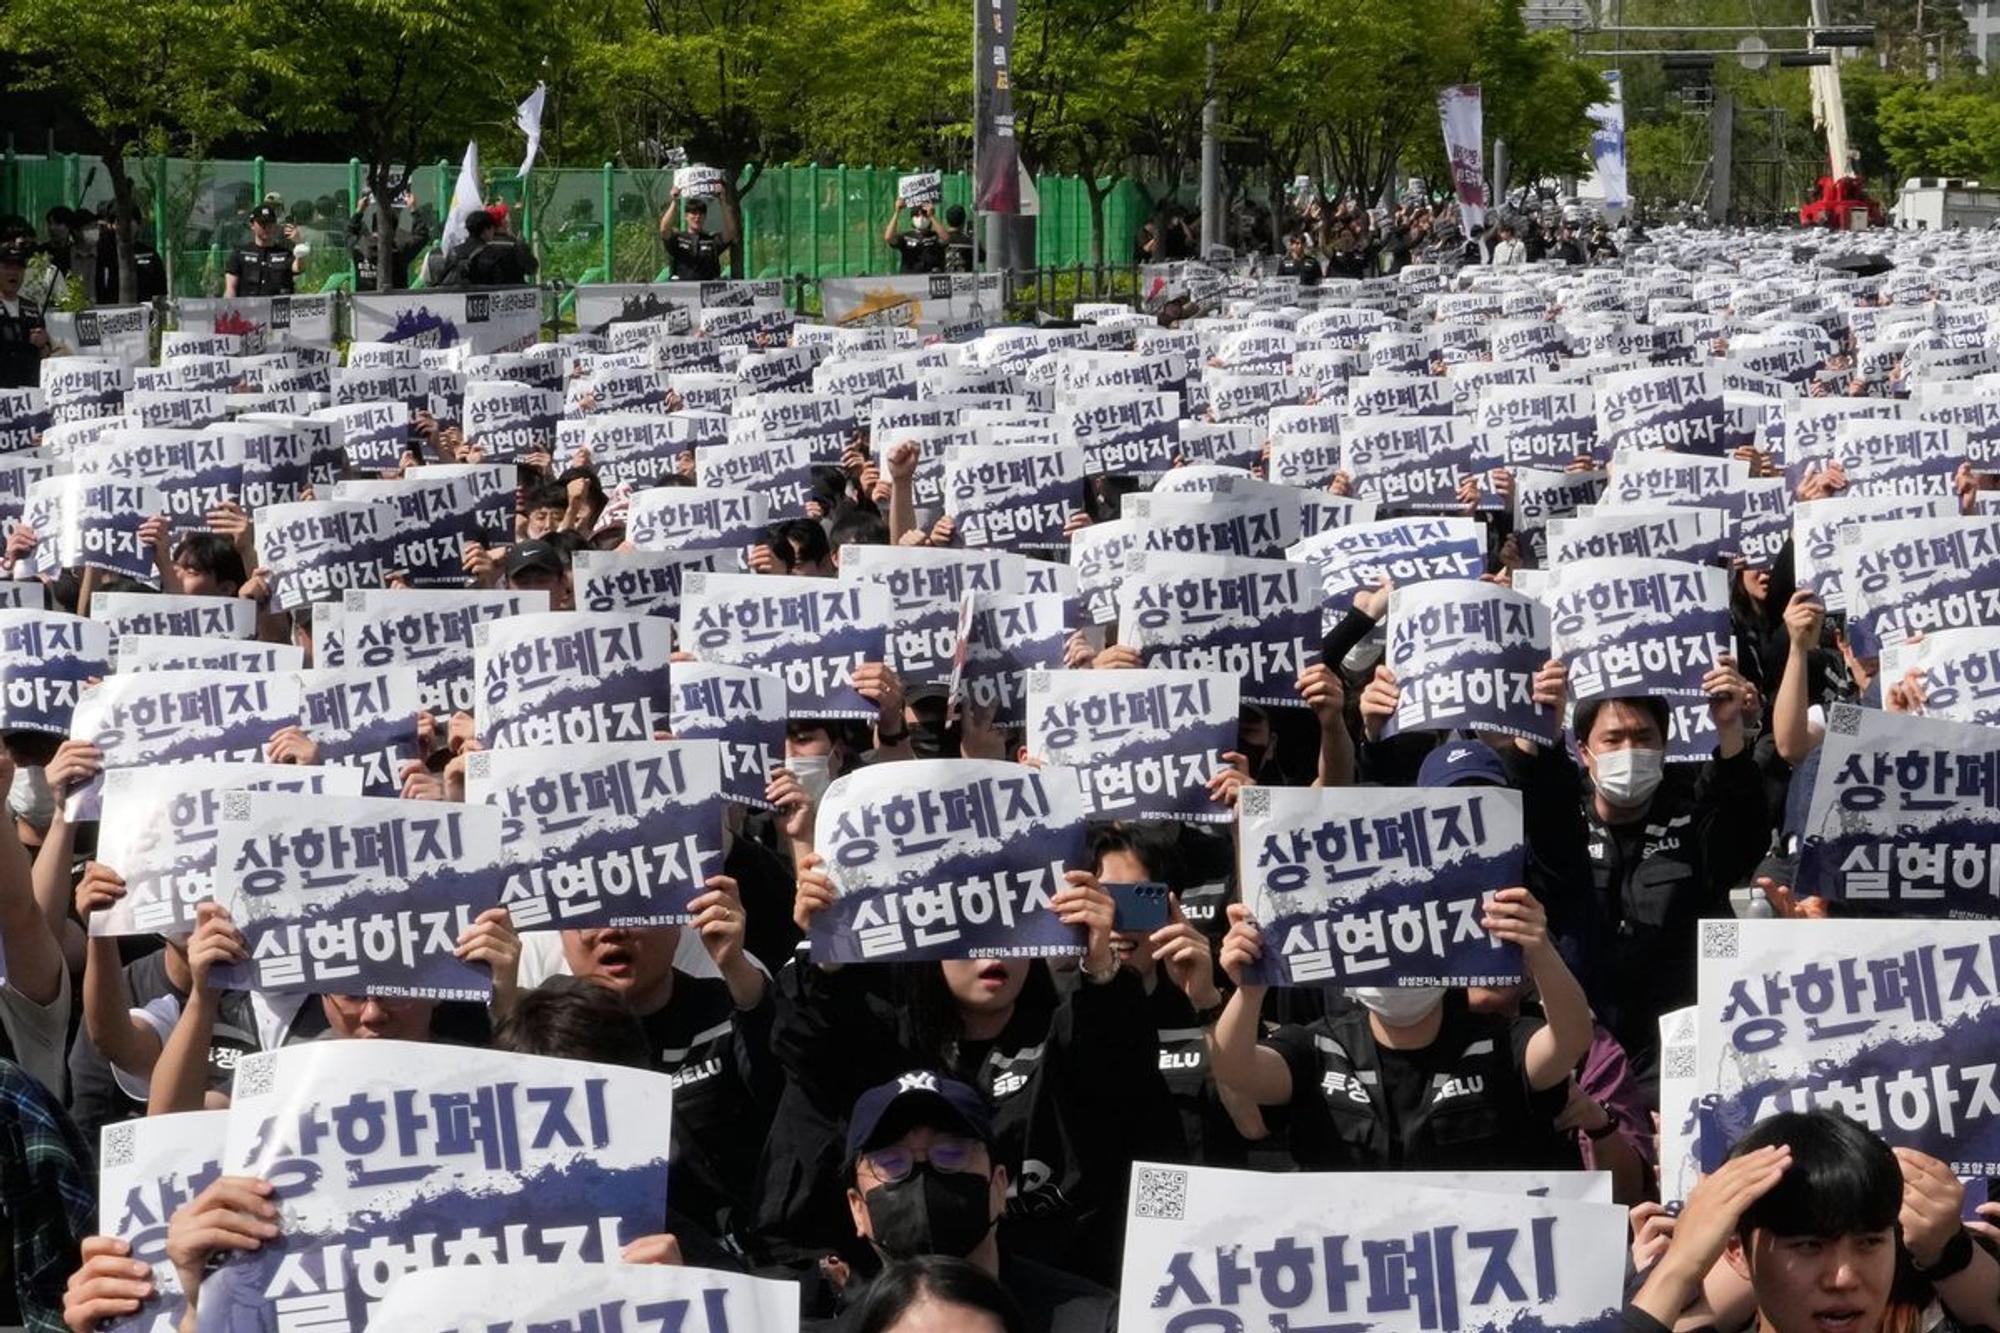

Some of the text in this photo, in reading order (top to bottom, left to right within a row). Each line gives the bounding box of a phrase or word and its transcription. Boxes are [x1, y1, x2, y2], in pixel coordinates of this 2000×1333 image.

[658, 340, 713, 362] 상한폐지
[1140, 333, 1200, 356] 상한폐지
[1496, 326, 1556, 353] 상한폐지
[1618, 332, 1683, 355] 상한폐지
[50, 370, 122, 398] 상한폐지
[336, 376, 417, 404] 상한폐지
[592, 372, 661, 402] 상한폐지
[828, 365, 904, 396] 상한폐지
[1216, 379, 1288, 410] 상한폐지
[1355, 382, 1440, 416] 상한폐지
[1453, 367, 1536, 402] 상한폐지
[1603, 372, 1707, 423] 상한폐지
[470, 394, 548, 424] 상한폐지
[762, 400, 841, 432] 상한폐지
[1073, 397, 1165, 437] 상한폐지
[1485, 393, 1577, 429] 상한폐지
[1620, 417, 1723, 451] 실현하자
[108, 437, 225, 481] 상한폐지
[591, 422, 674, 454] 상한폐지
[1084, 435, 1178, 474] 실현하자
[1347, 421, 1455, 465] 상한폐지
[1840, 429, 1949, 468] 상한폐지
[703, 445, 792, 488] 상한폐지
[954, 452, 1063, 499] 상한폐지
[1359, 463, 1466, 501] 실현하자
[1619, 464, 1729, 502] 상한폐지
[263, 507, 378, 562] 상한폐지
[634, 489, 754, 543] 상한폐지
[961, 500, 1077, 546] 실현하자
[1146, 507, 1282, 557] 상한폐지
[1558, 518, 1678, 561] 상한폐지
[1304, 520, 1452, 566] 상한폐지
[1855, 522, 2000, 594] 상한폐지
[277, 556, 386, 609] 실현하자
[584, 553, 716, 612] 상한폐지
[857, 559, 1002, 610] 한폐지
[1321, 551, 1480, 593] 실현하자
[694, 587, 863, 649] 상한폐지
[1134, 568, 1299, 629] 상한폐지
[1552, 570, 1707, 636] 상한폐지
[357, 597, 521, 667] 상한폐지
[1391, 599, 1534, 664] 상한폐지
[483, 620, 643, 705] 상한폐지
[1147, 636, 1323, 686] 실현하자
[1568, 631, 1724, 699] 실현하자
[93, 680, 268, 750] 상한폐지
[1040, 678, 1212, 750] 상한폐지
[1398, 666, 1545, 731] 실현하자
[486, 748, 687, 846] 상한폐지
[829, 773, 1051, 867] 상한폐지
[234, 811, 463, 897] 상한폐지
[1257, 796, 1487, 893] 상한폐지
[500, 833, 721, 930] 실현하자
[851, 860, 1070, 959] 실현하자
[253, 904, 477, 988] 실현하자
[1281, 888, 1505, 984] 실현하자
[1721, 934, 2000, 1053] 상한폐지
[243, 1078, 610, 1201] 상한폐지
[1151, 1215, 1558, 1333] 상한폐지
